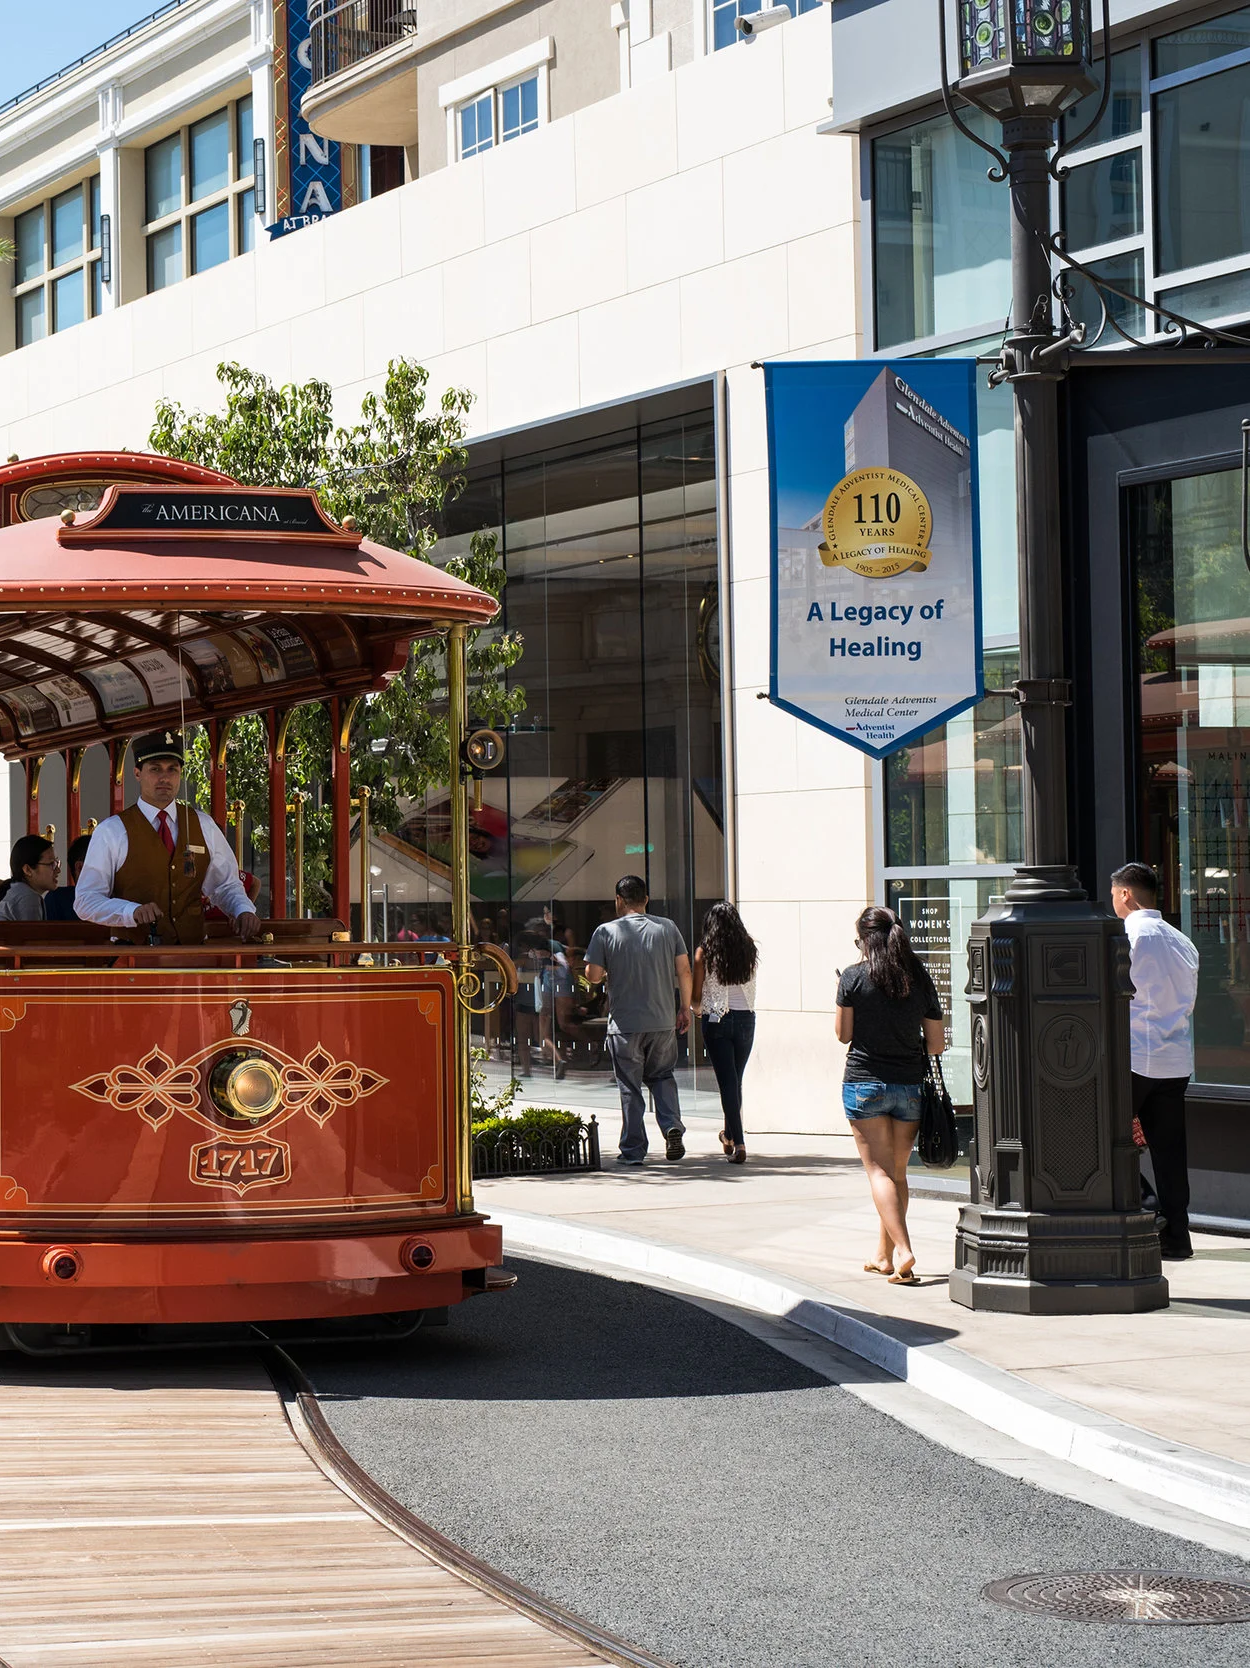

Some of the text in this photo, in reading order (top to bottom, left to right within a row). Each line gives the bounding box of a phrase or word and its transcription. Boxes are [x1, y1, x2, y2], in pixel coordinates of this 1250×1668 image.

[895, 376, 937, 419] Glendale
[908, 405, 944, 442] Adventist
[155, 504, 281, 522] AMERICANA
[827, 472, 927, 541] GLENDALE ADVENTIST MEDICAL CENTER
[853, 492, 901, 524] 110
[859, 528, 895, 537] YEARS
[831, 545, 927, 561] A LEGACY OF HEALING
[855, 563, 873, 573] 1905
[882, 562, 900, 574] 2015
[806, 599, 945, 626] A Legacy of
[830, 636, 922, 661] Healing
[845, 696, 937, 705] Glendale Adventist
[845, 707, 919, 717] Medical Center
[856, 722, 895, 731] Adventist
[866, 732, 895, 740] Health
[910, 920, 951, 929] WOMEN'S
[200, 1149, 279, 1177] 1717
